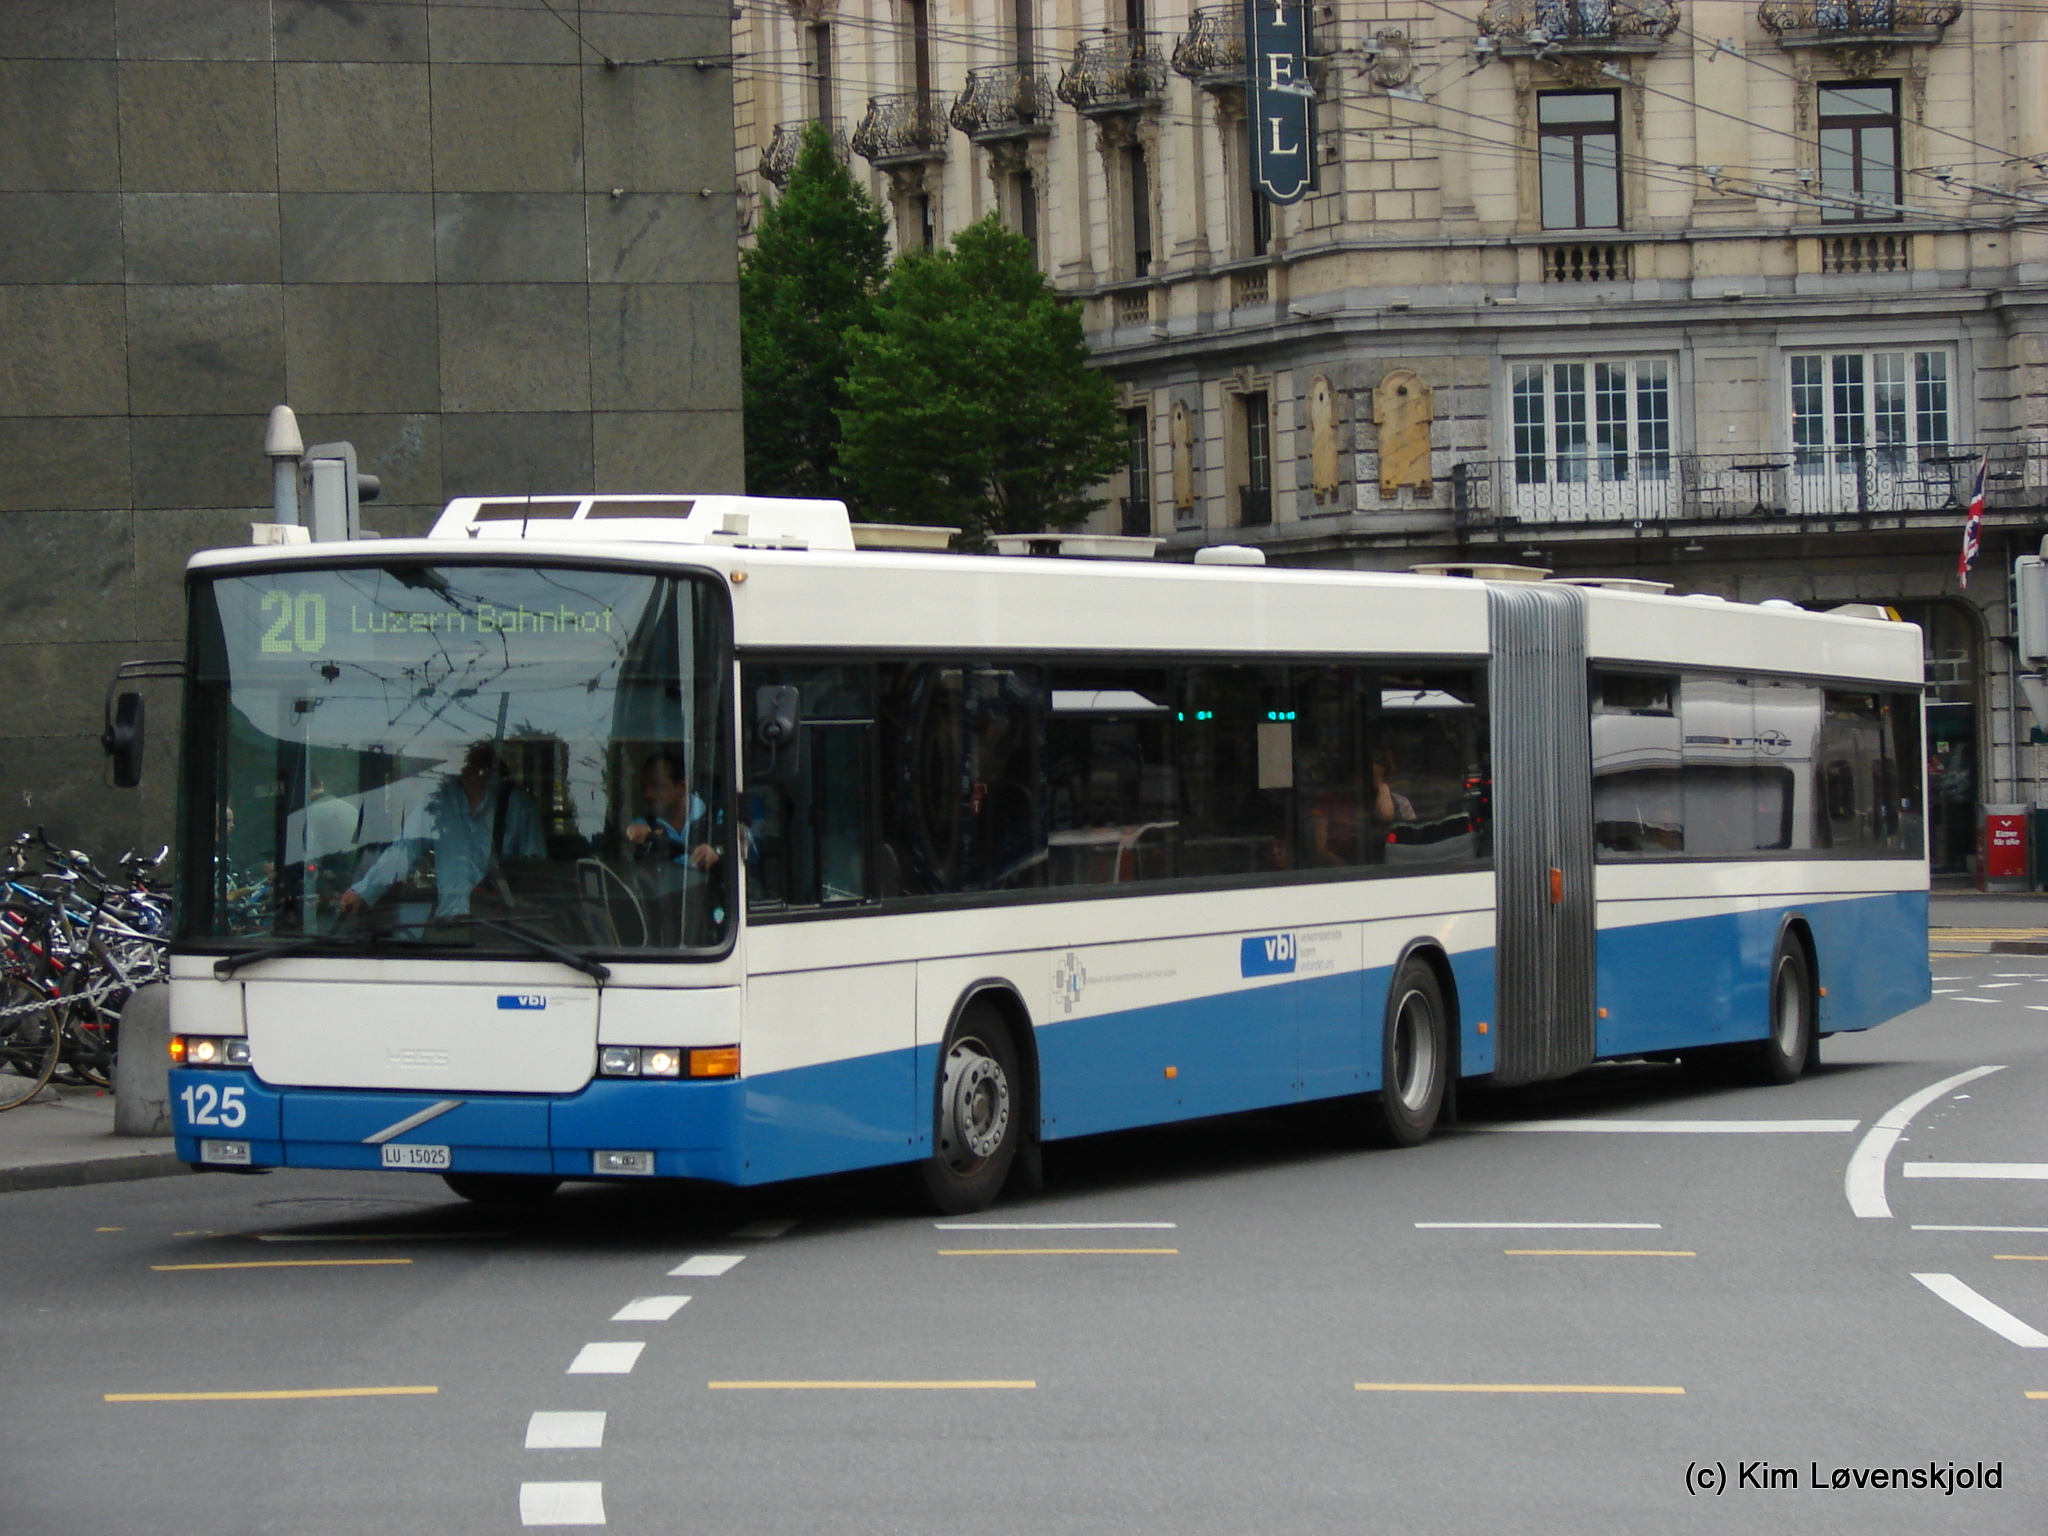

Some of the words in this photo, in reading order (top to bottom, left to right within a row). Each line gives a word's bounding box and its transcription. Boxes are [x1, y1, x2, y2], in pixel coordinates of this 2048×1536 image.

[260, 590, 326, 653] 20
[351, 605, 465, 633] Luzern
[477, 603, 615, 633] Bahnhof
[1265, 933, 1295, 961] vbl
[518, 995, 545, 1007] vbl
[180, 1083, 247, 1128] 125
[385, 1149, 401, 1163] LU
[409, 1149, 446, 1165] 15025
